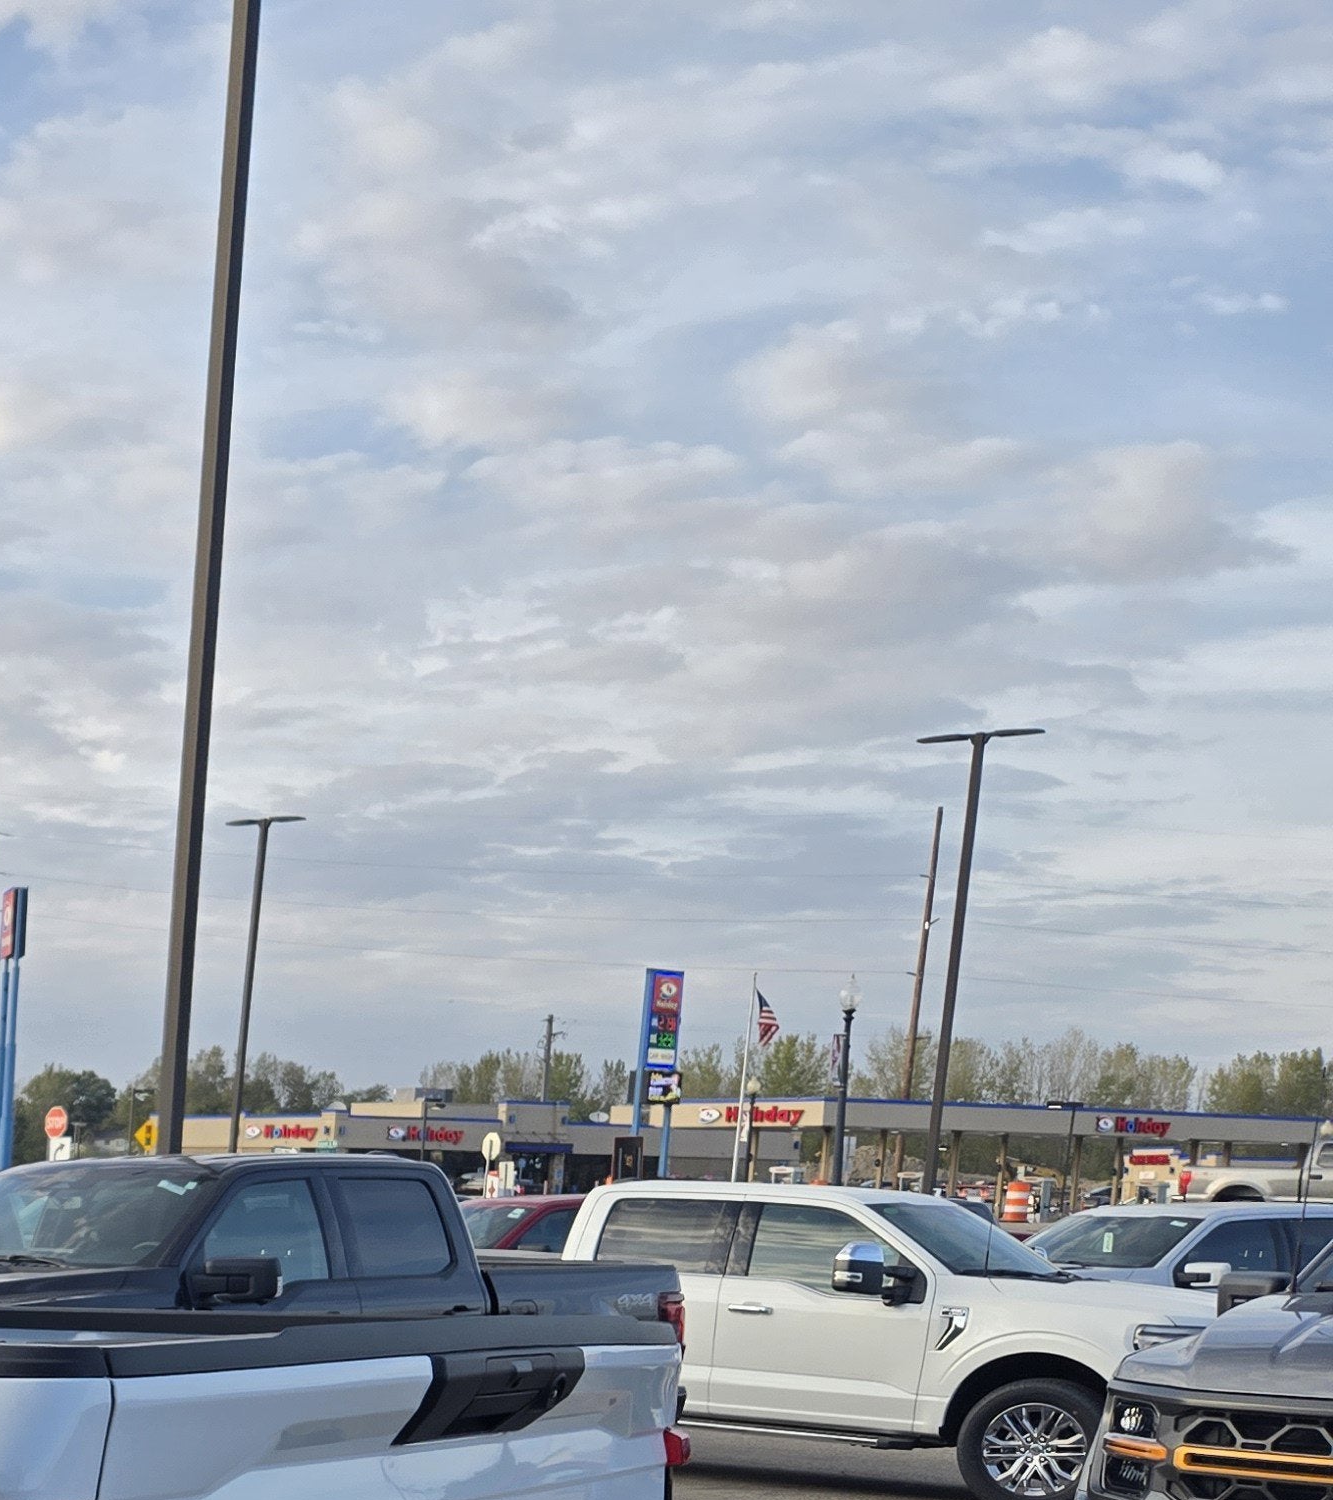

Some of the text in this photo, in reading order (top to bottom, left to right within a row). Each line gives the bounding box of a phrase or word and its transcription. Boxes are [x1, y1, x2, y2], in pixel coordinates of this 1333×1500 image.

[46, 1116, 67, 1130] STOP
[725, 1105, 805, 1126] Hliday
[263, 1124, 318, 1142] Holiday
[1114, 1116, 1171, 1138] Holiday
